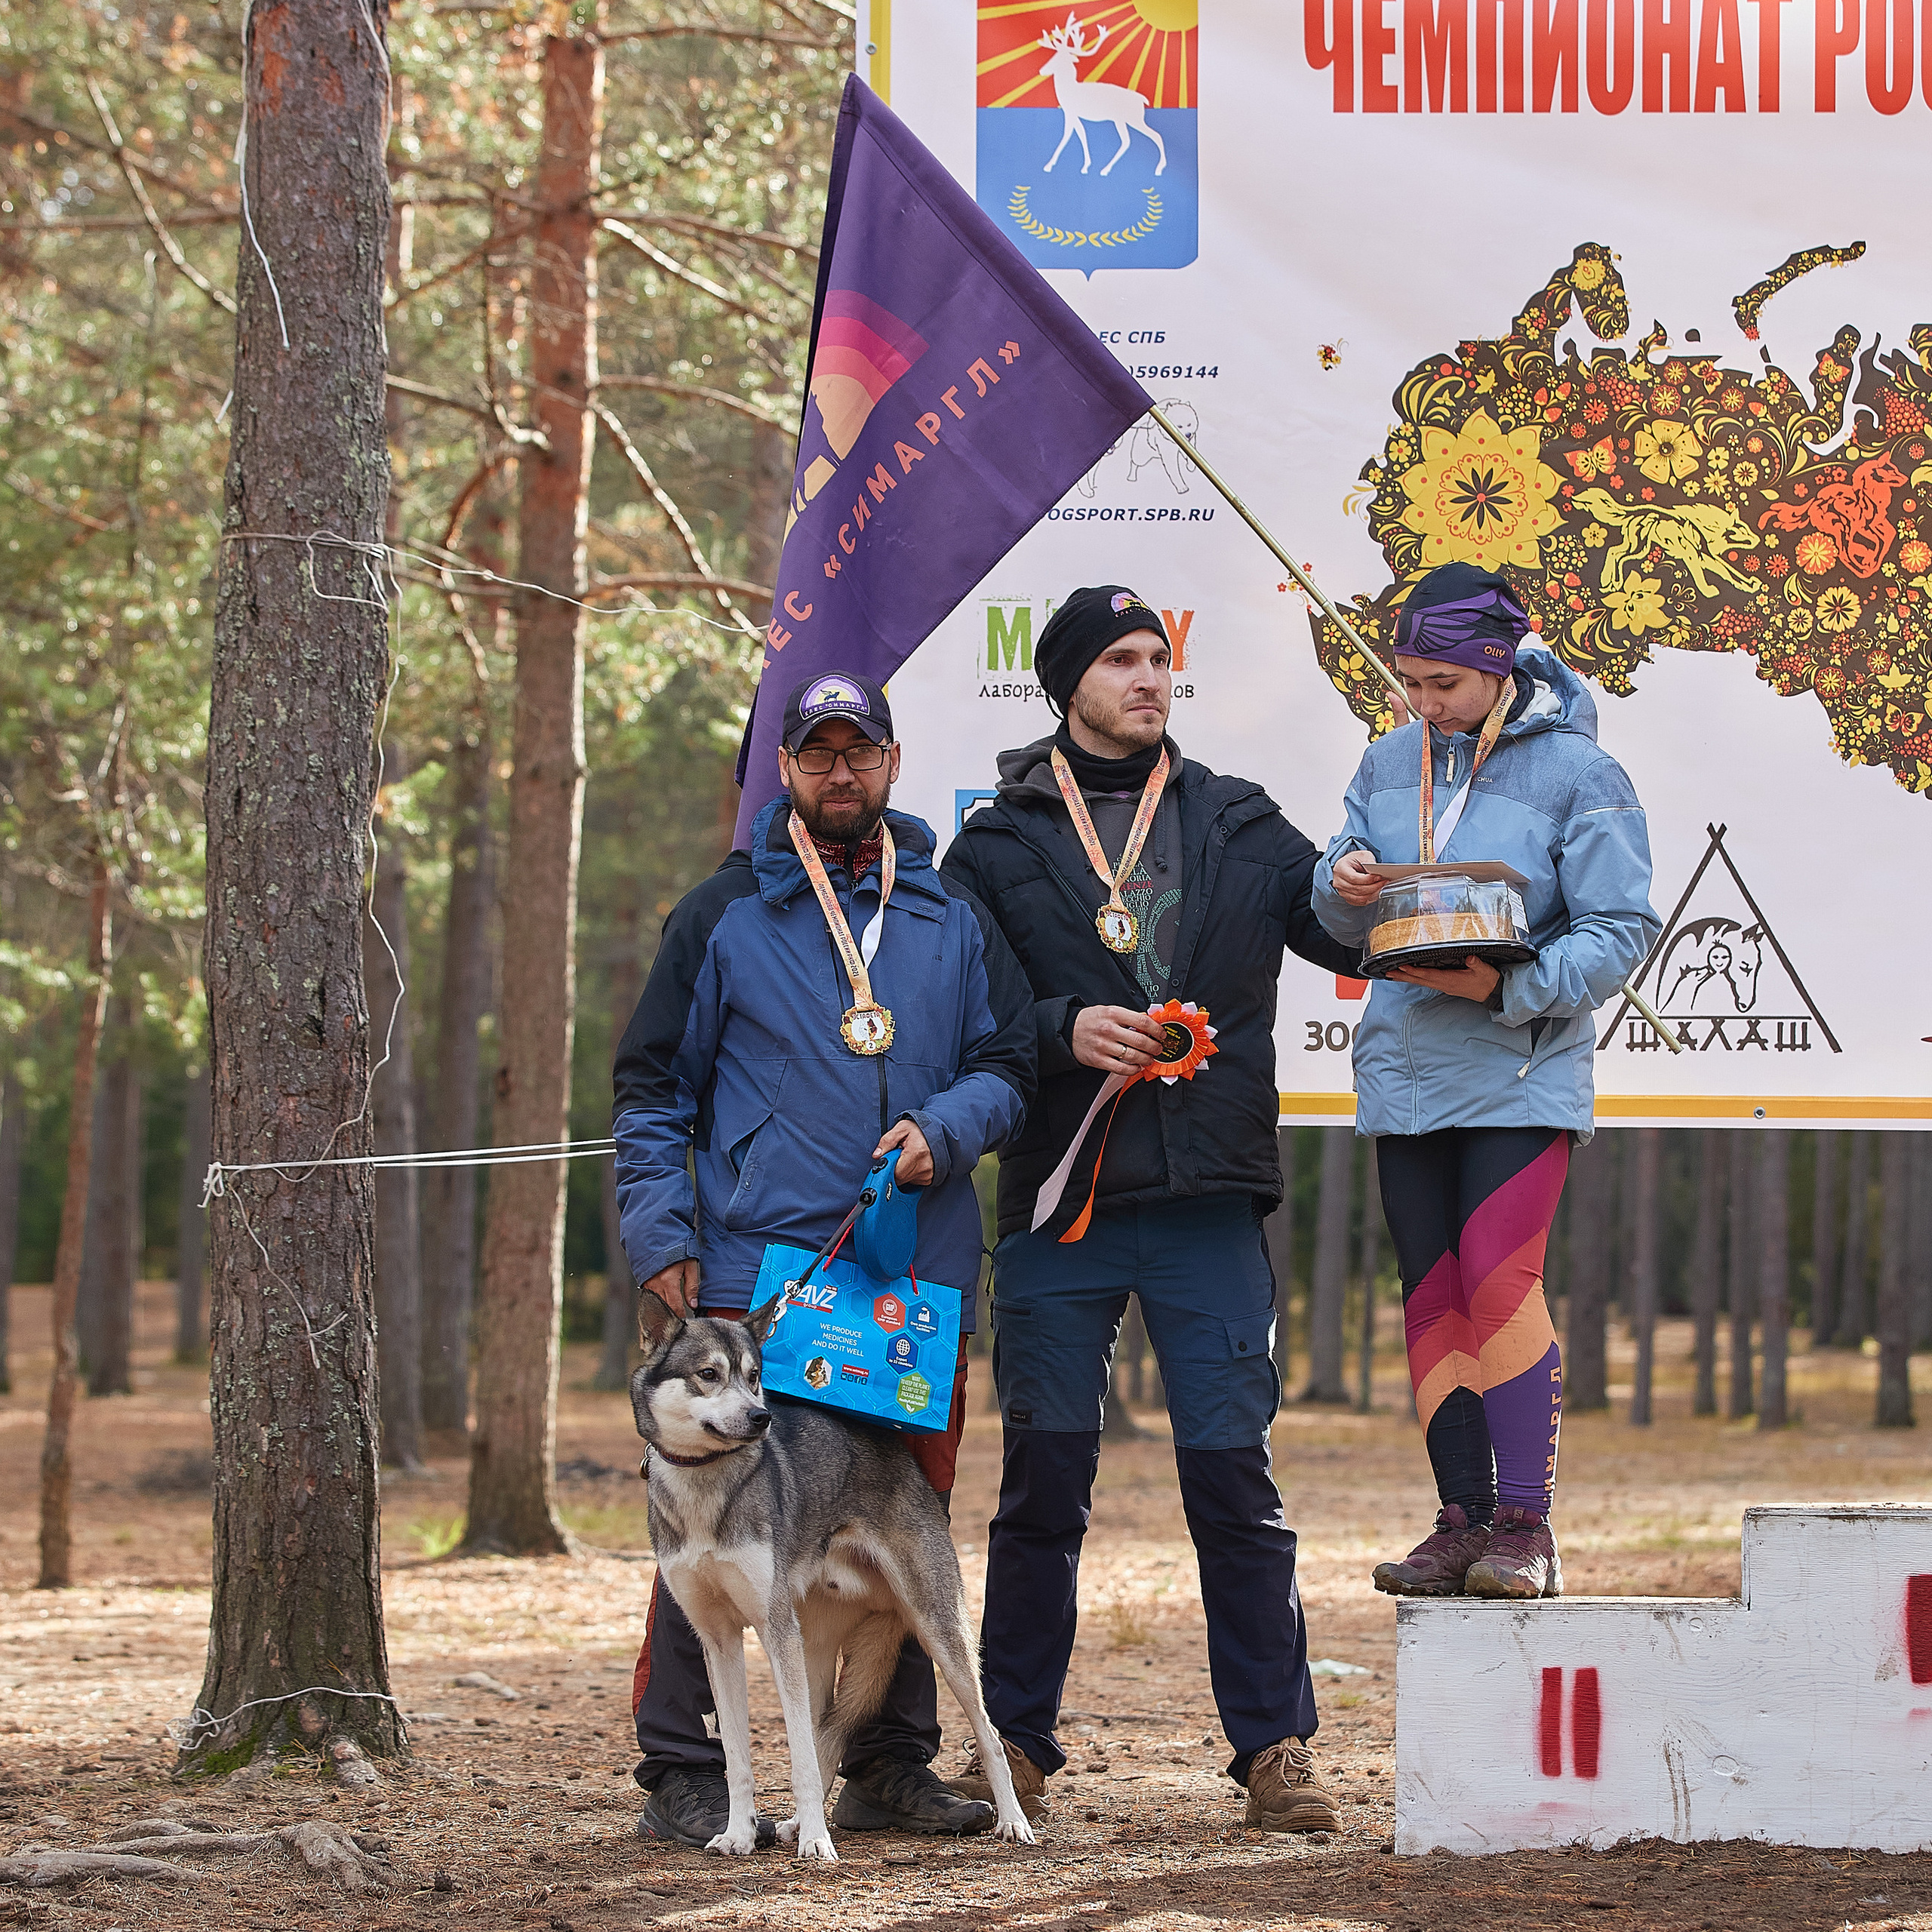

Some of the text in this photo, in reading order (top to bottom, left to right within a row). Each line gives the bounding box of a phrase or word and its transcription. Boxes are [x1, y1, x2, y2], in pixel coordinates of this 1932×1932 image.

[1304, 0, 1932, 115] ЧЕМПИОНАТ РО
[1099, 331, 1166, 343] ЕС СПБ
[1130, 365, 1219, 378] )5969144
[823, 340, 1020, 579] «СИМАРГЛ»
[1048, 508, 1214, 521] OGSPORT.SPB.RU
[979, 684, 1045, 702] лабора
[1494, 706, 1504, 718] 2021
[1087, 835, 1096, 846] 2021
[1119, 866, 1128, 878] 2021
[1120, 888, 1153, 897] ALAZZO
[1121, 881, 1154, 891] RENZE
[1122, 895, 1151, 903] ECCHIO
[1124, 901, 1149, 909] IGLIO
[839, 936, 851, 955] РОССИИ
[851, 964, 860, 977] 2021
[1626, 1019, 1811, 1052] ШАЛАШ
[820, 1322, 863, 1339] WE PRODUCE
[822, 1332, 857, 1346] MEDICINES
[811, 1340, 827, 1348] AND
[828, 1343, 838, 1351] DO
[846, 1347, 864, 1357] WELL
[1543, 1366, 1561, 1501] ИМАРГЛ
